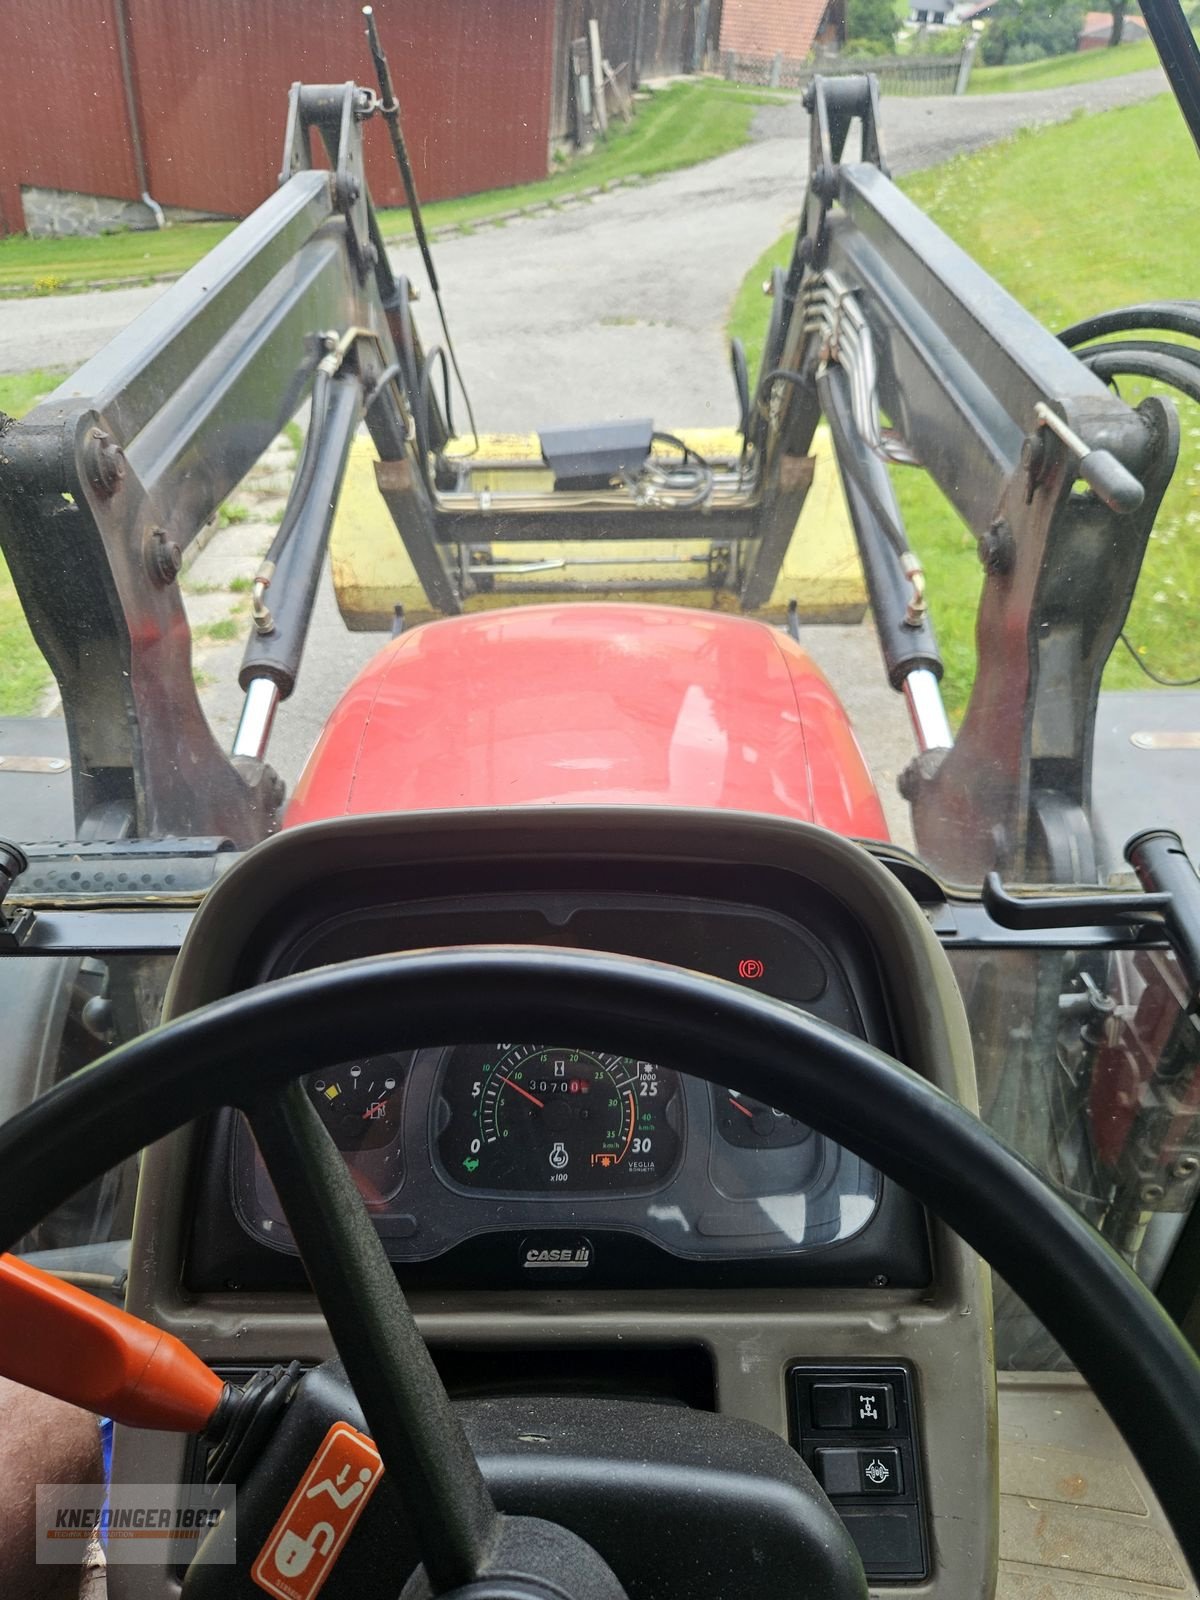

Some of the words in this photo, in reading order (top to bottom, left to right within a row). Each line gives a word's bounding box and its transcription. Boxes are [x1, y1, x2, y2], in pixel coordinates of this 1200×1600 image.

[540, 1054, 548, 1062] 15
[569, 1054, 579, 1062] 20
[514, 1072, 522, 1080] 10
[594, 1072, 604, 1080] 25
[639, 1073, 656, 1081] 1000
[471, 1081, 481, 1096] 5
[639, 1081, 658, 1097] 25
[608, 1099, 618, 1107] 30
[641, 1113, 652, 1121] 40
[470, 1138, 481, 1153] 0
[631, 1138, 652, 1153] 30
[550, 1173, 568, 1182] x100
[526, 1249, 572, 1261] CASE
